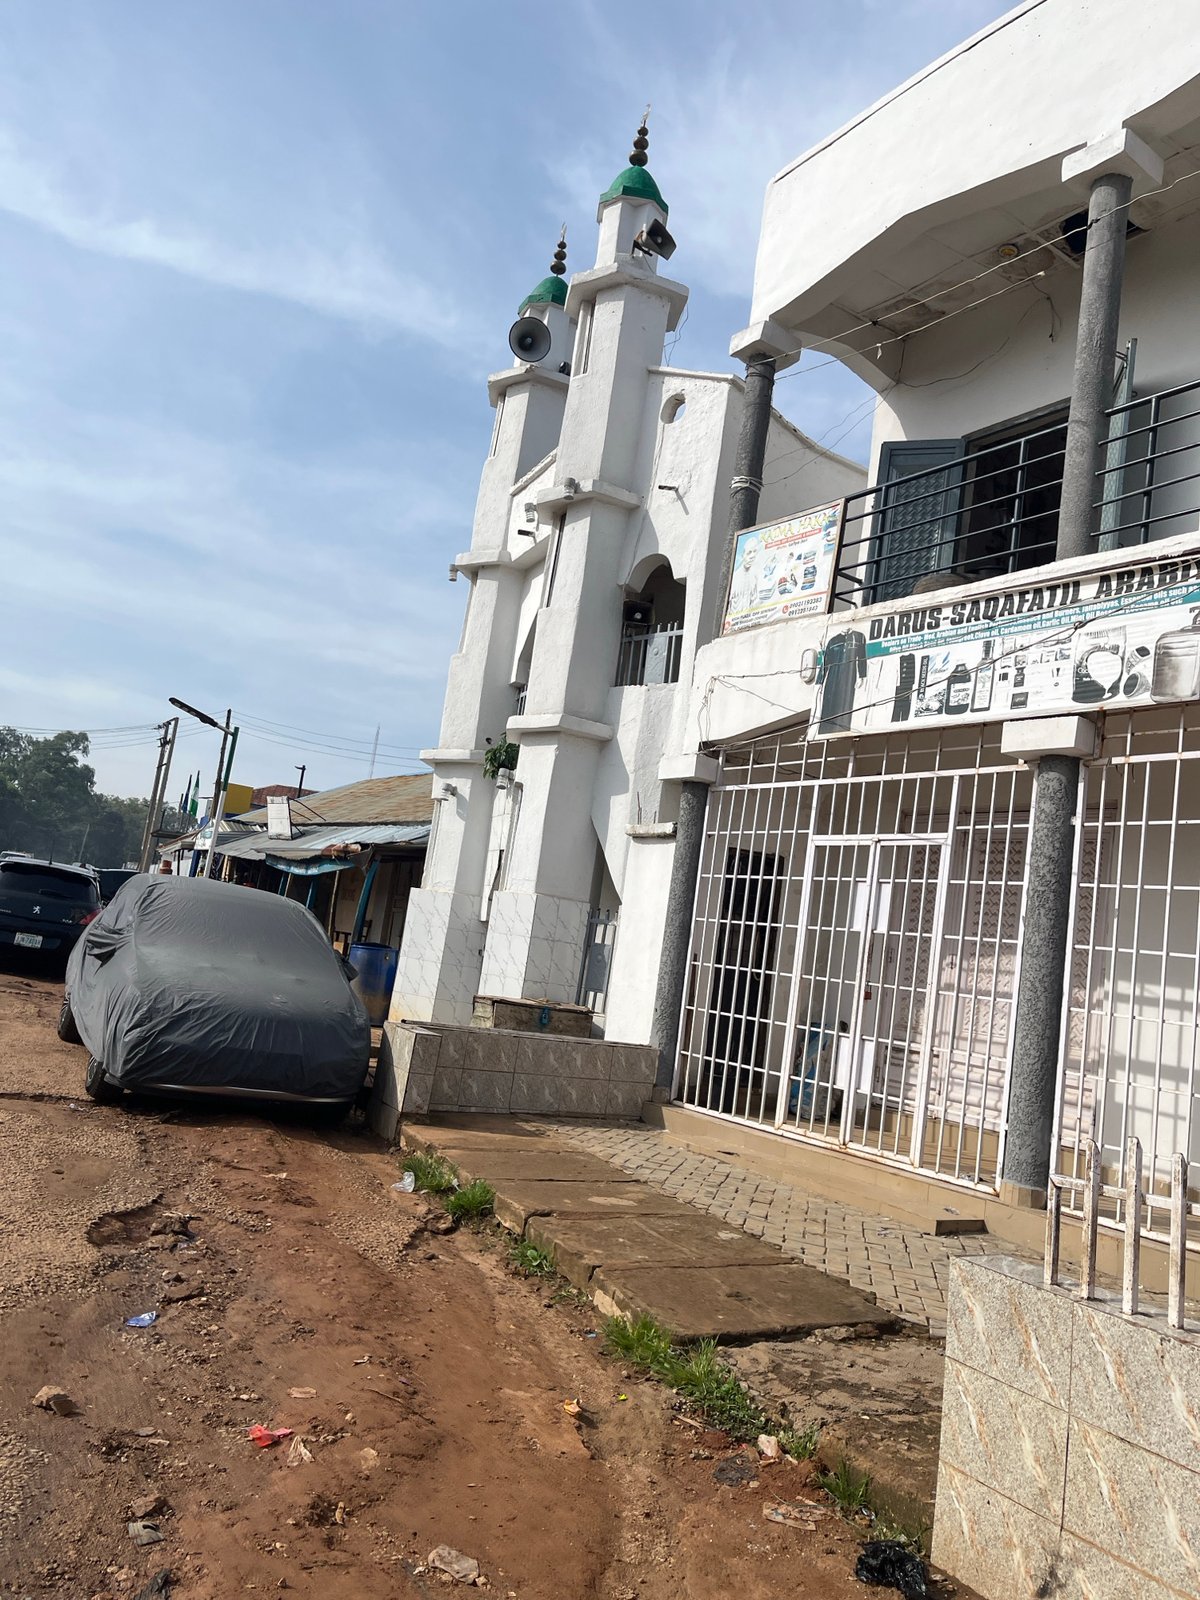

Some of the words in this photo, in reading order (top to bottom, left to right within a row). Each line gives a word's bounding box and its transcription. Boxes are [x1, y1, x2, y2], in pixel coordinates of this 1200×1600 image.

[869, 580, 1081, 641] DARUS-SAQAFATIL
[1094, 556, 1200, 600] ARABI
[1169, 586, 1187, 597] such
